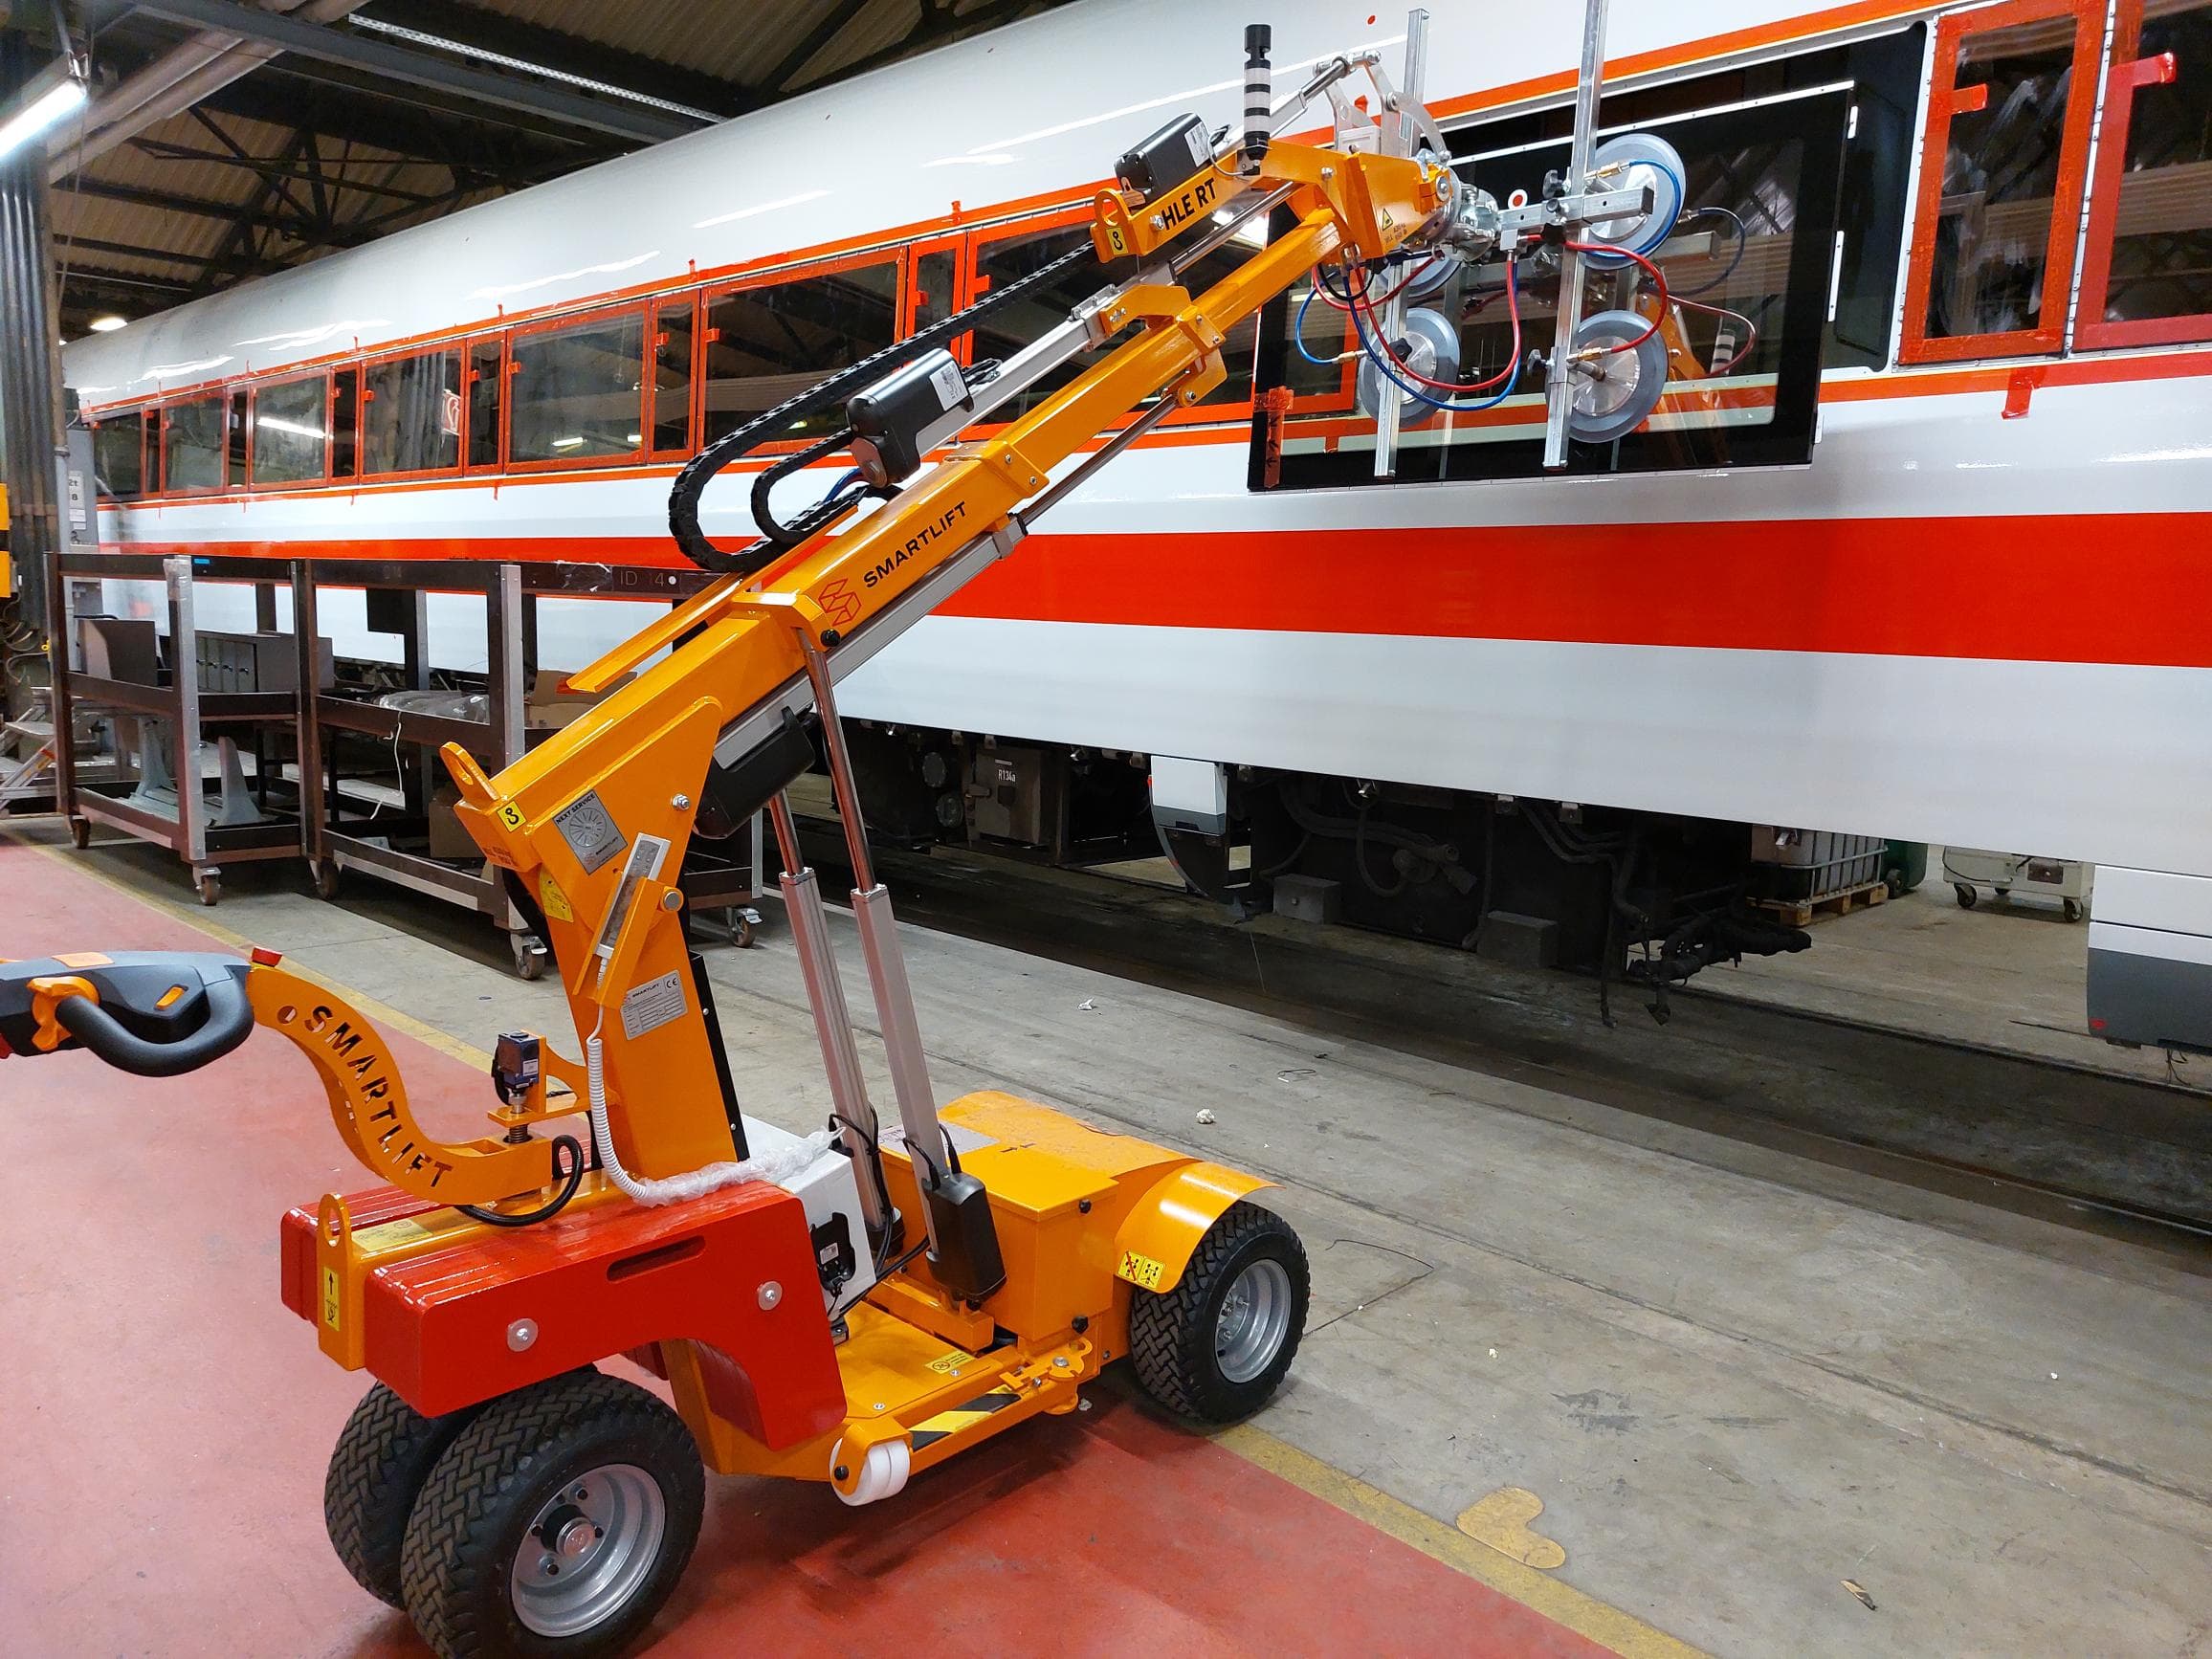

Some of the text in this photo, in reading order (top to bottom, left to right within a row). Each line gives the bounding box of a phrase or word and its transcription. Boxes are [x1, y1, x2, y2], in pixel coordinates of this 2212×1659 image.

[1161, 177, 1216, 231] HLE RT
[863, 500, 966, 588] SMARTLIFT
[620, 570, 665, 586] ID 4
[998, 769, 1016, 783] R134a
[555, 793, 596, 825] NEXT SERVICE
[304, 1006, 453, 1187] SMARTLIFT
